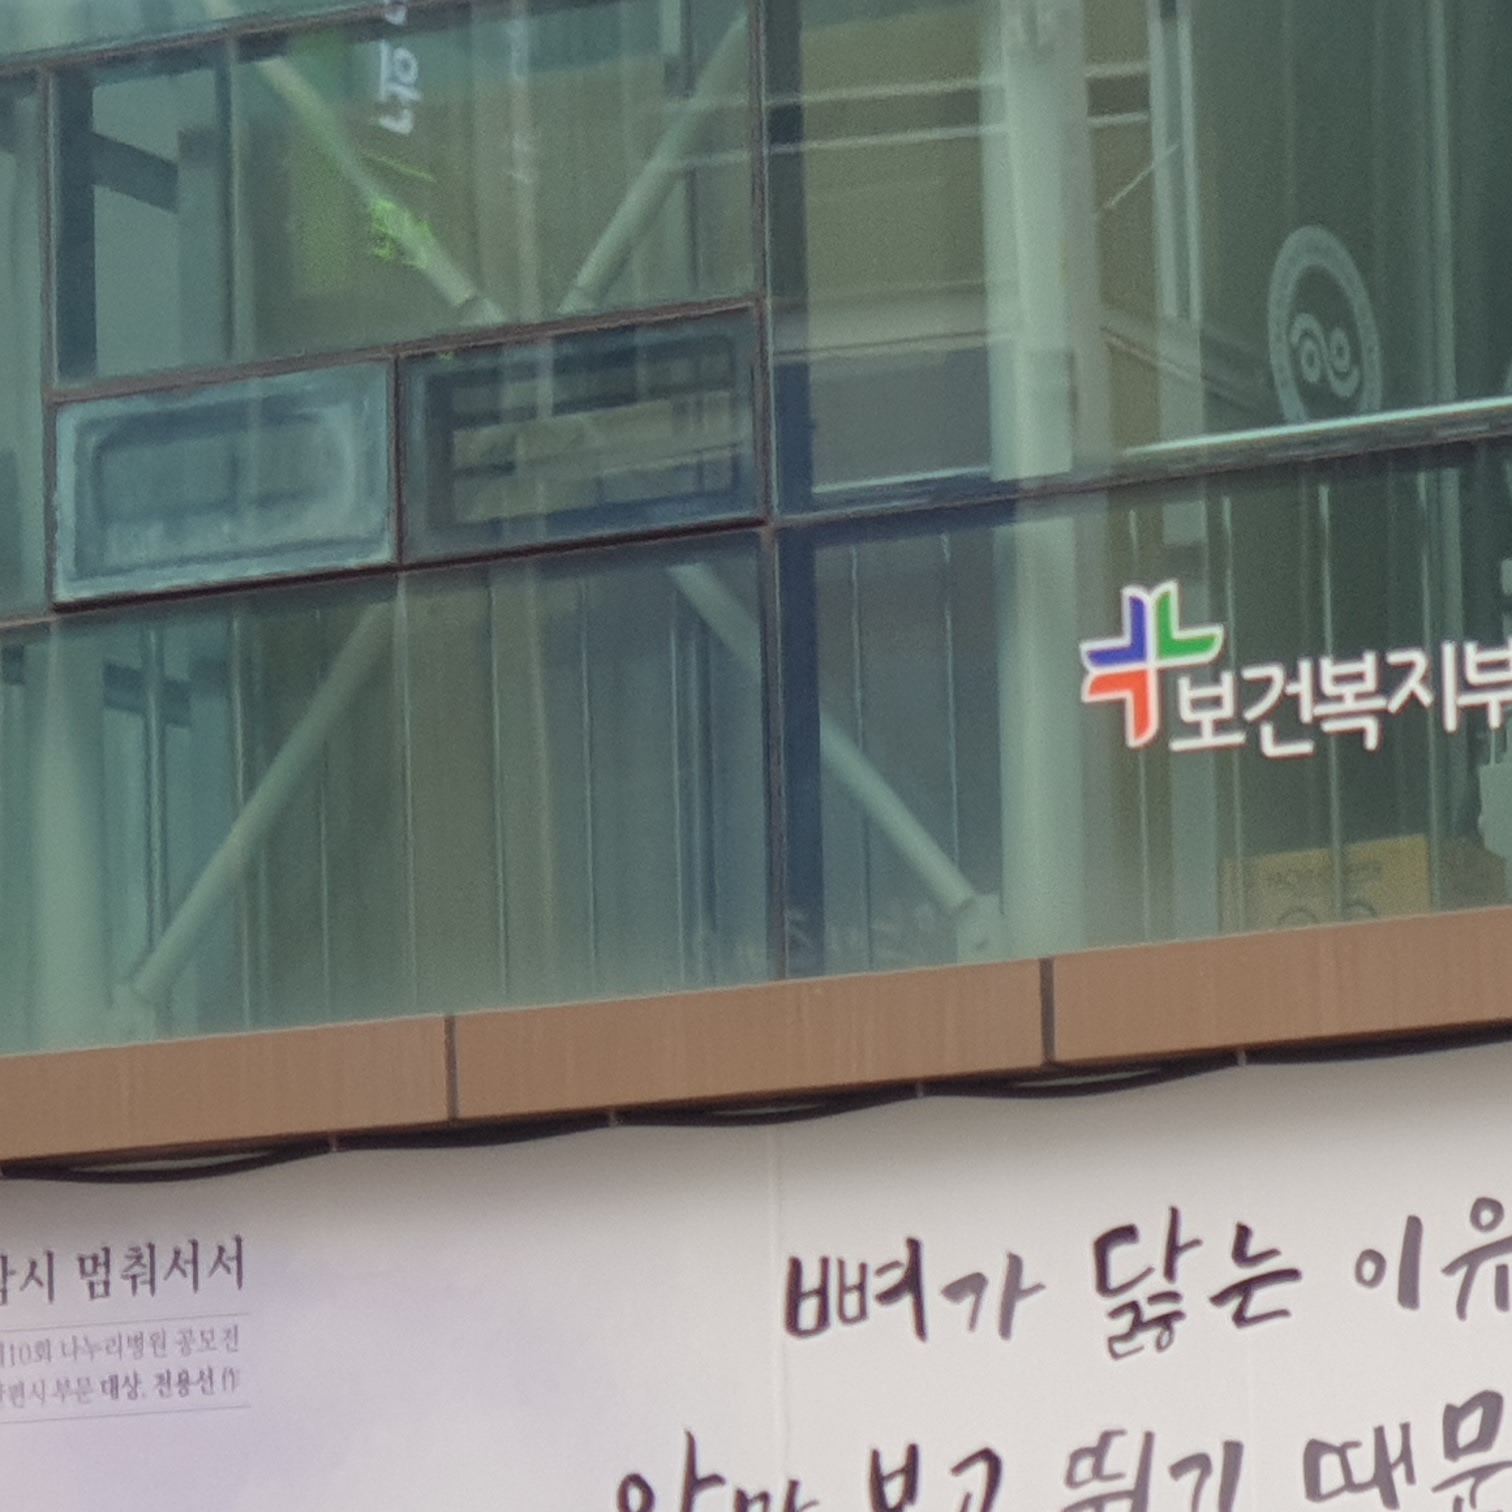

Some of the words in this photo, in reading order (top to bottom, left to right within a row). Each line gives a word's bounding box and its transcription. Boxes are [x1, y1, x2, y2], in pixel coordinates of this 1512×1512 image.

[77, 1233, 244, 1301] 멈춰서서
[784, 1236, 1045, 1342] 뼈가
[1093, 1206, 1303, 1360] 닳는
